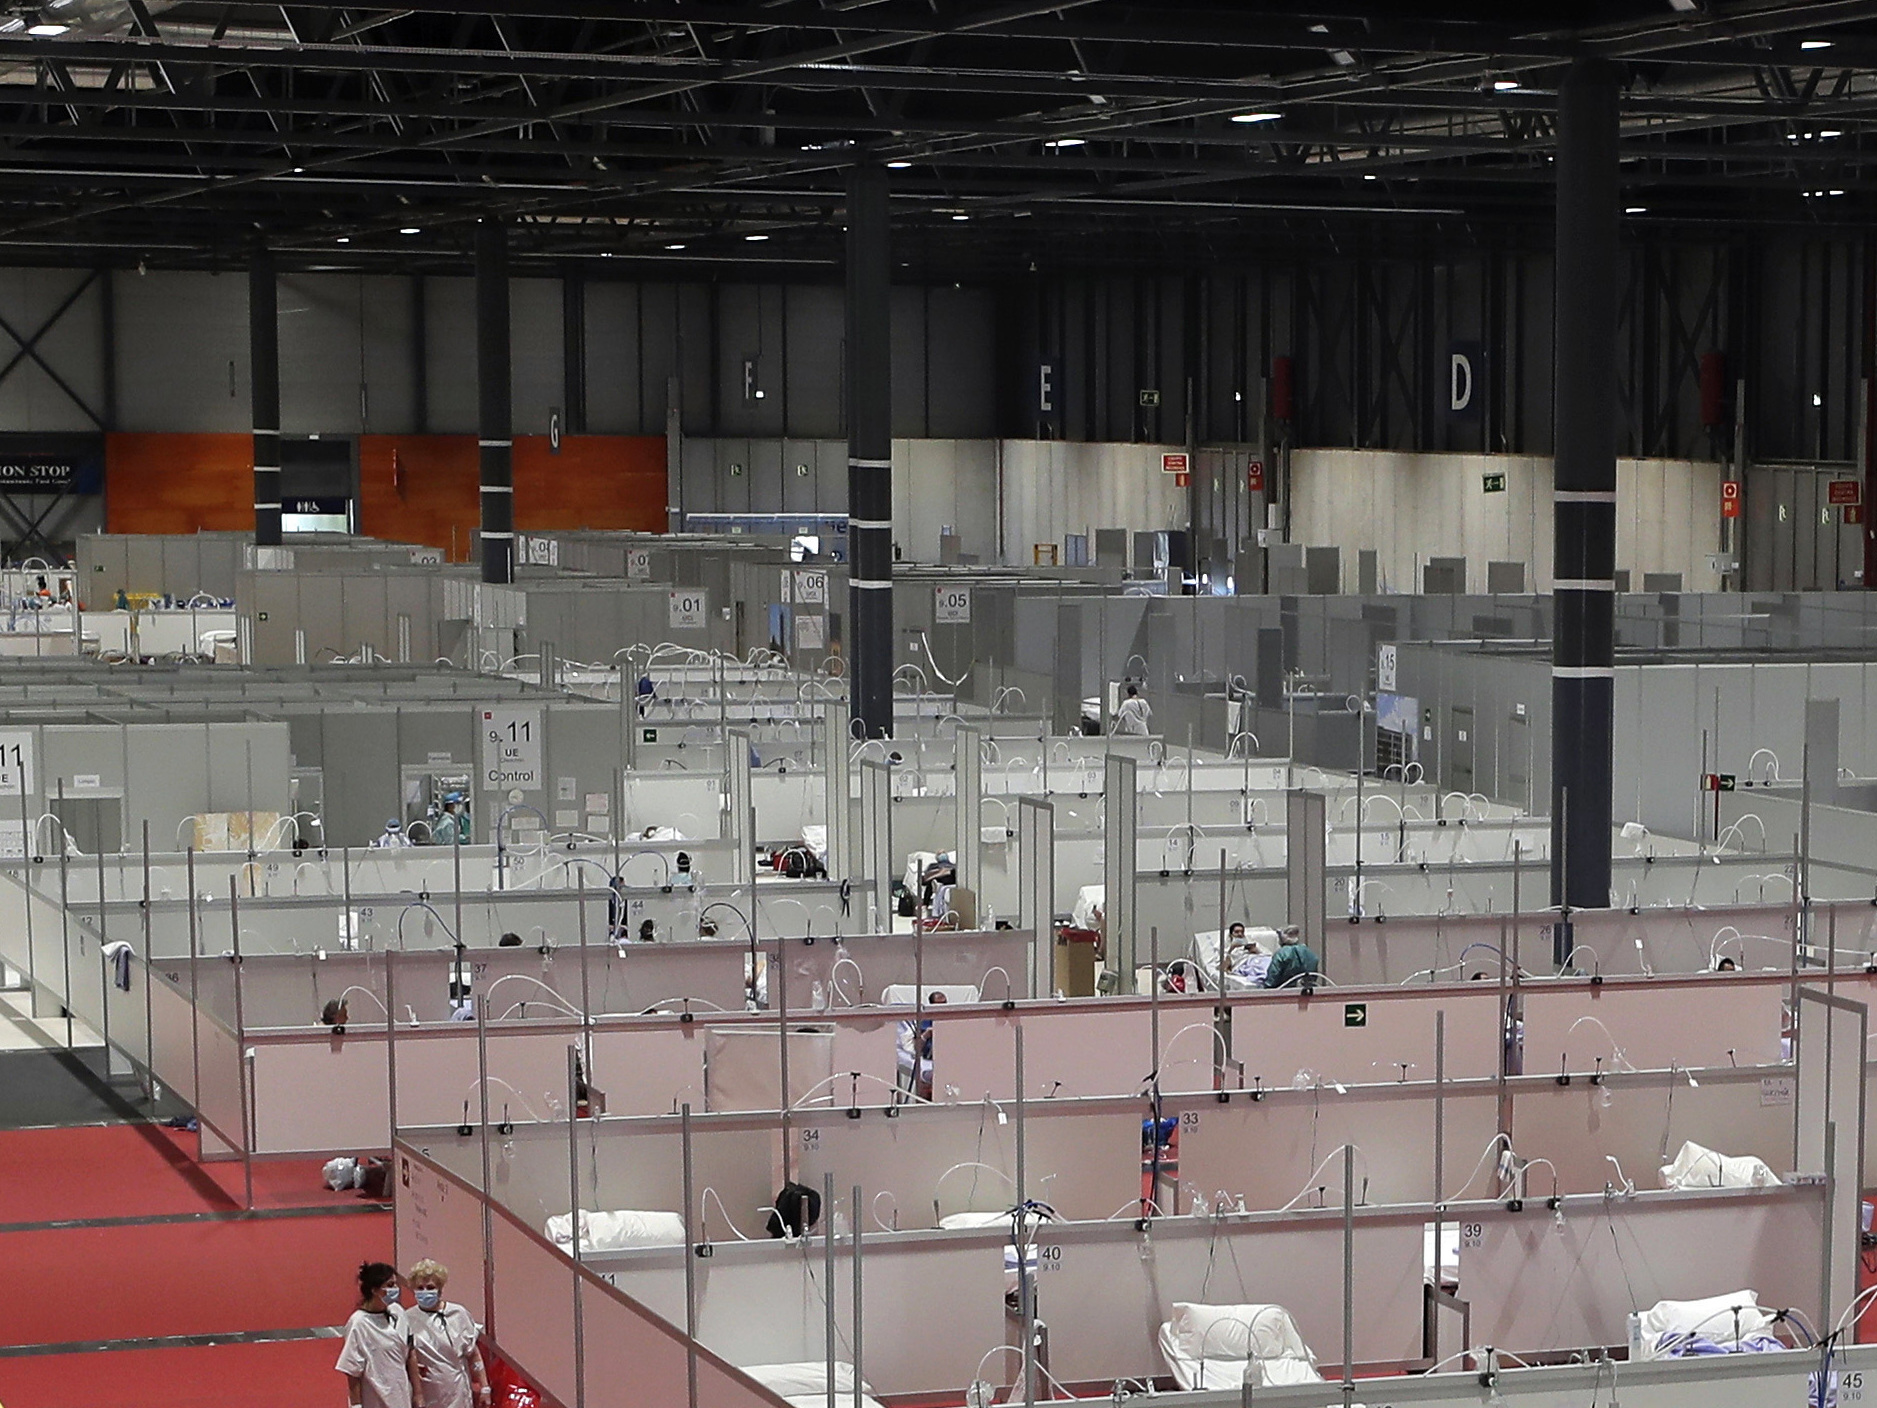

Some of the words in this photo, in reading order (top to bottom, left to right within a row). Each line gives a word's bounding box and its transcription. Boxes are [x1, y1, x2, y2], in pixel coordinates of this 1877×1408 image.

[1041, 366, 1052, 411] E
[1452, 354, 1471, 410] D
[551, 414, 559, 448] G
[0, 465, 24, 477] ON
[30, 465, 70, 477] STOP
[490, 721, 533, 743] 9.11
[505, 748, 519, 758] UE
[488, 769, 535, 783] Control
[1183, 1112, 1199, 1125] 33
[803, 1129, 819, 1142] 34
[1464, 1223, 1482, 1238] 39
[1042, 1246, 1061, 1261] 40
[1842, 1372, 1864, 1389] 45
